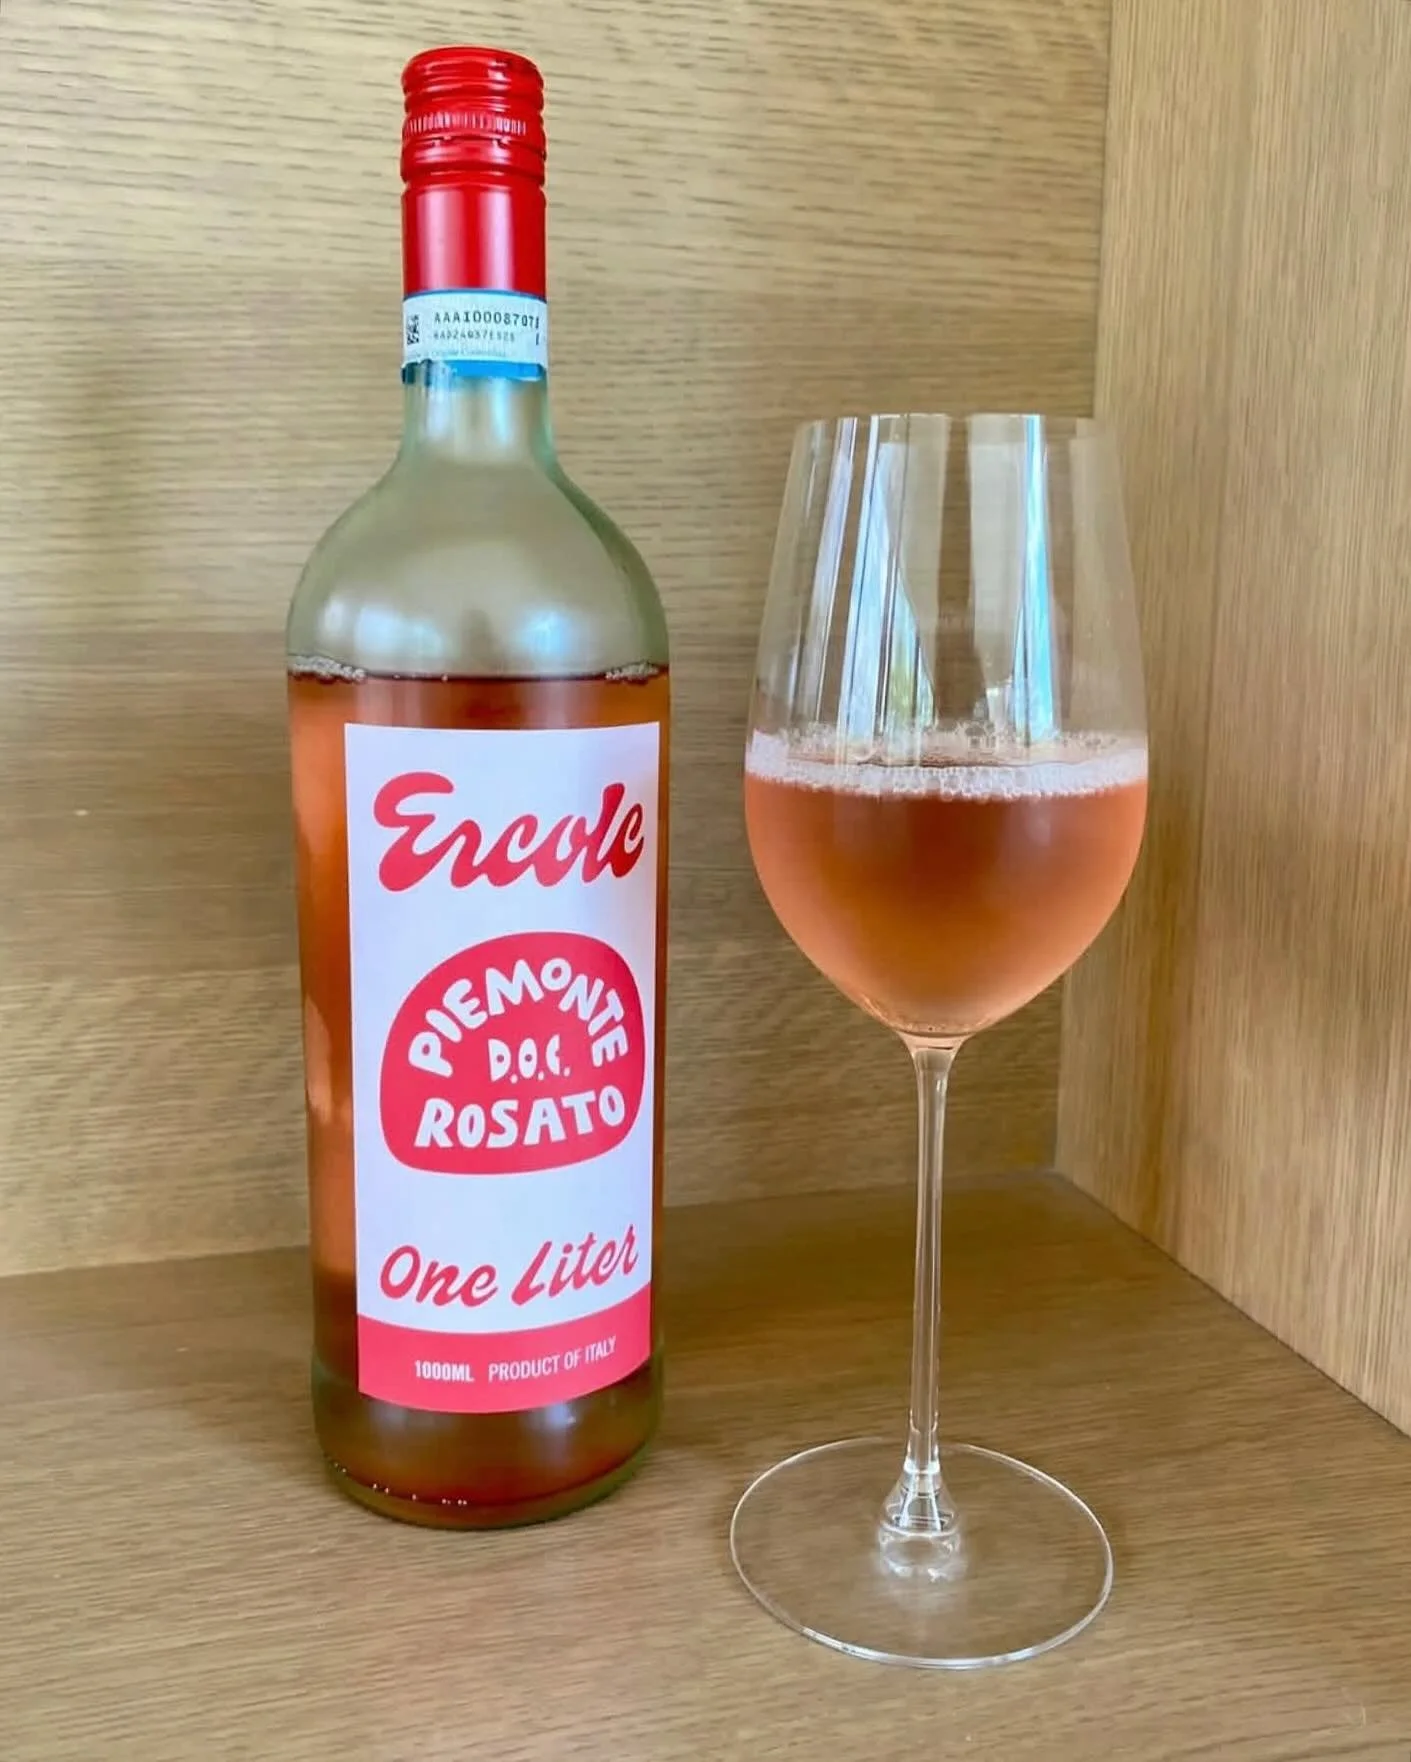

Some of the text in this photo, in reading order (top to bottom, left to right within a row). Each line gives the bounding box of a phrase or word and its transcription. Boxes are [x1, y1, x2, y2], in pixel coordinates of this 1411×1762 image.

[373, 771, 645, 892] Ercole
[408, 957, 629, 1078] PIEMONTE
[487, 1034, 571, 1084] D.O.C.
[414, 1085, 626, 1149] ROSATO
[380, 1224, 638, 1307] One Liter
[415, 1335, 616, 1382] 1000ML PRODUCT OF ITALY
